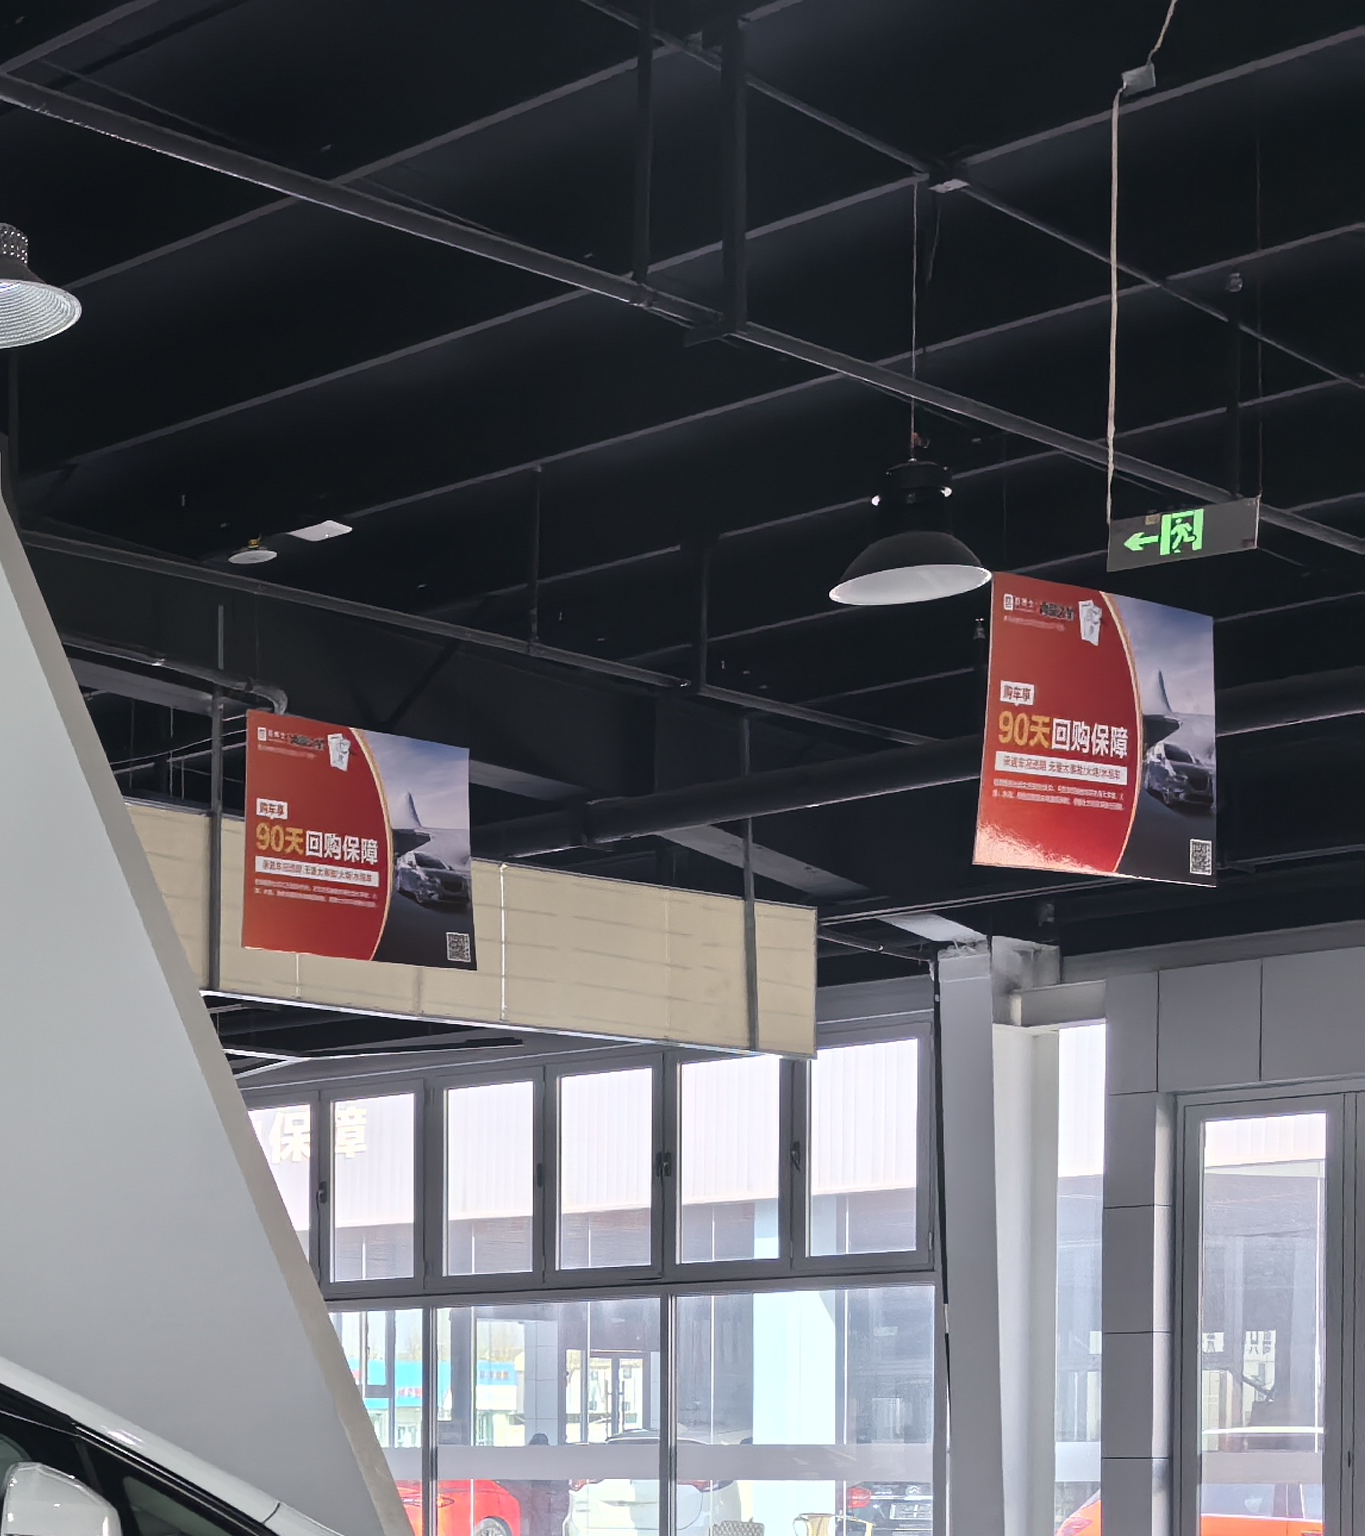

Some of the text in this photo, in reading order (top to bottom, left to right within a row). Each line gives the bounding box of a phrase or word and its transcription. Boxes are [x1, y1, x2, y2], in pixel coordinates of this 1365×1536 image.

[998, 710, 1129, 760] 90天回购保障
[256, 822, 379, 866] 90天回购保障
